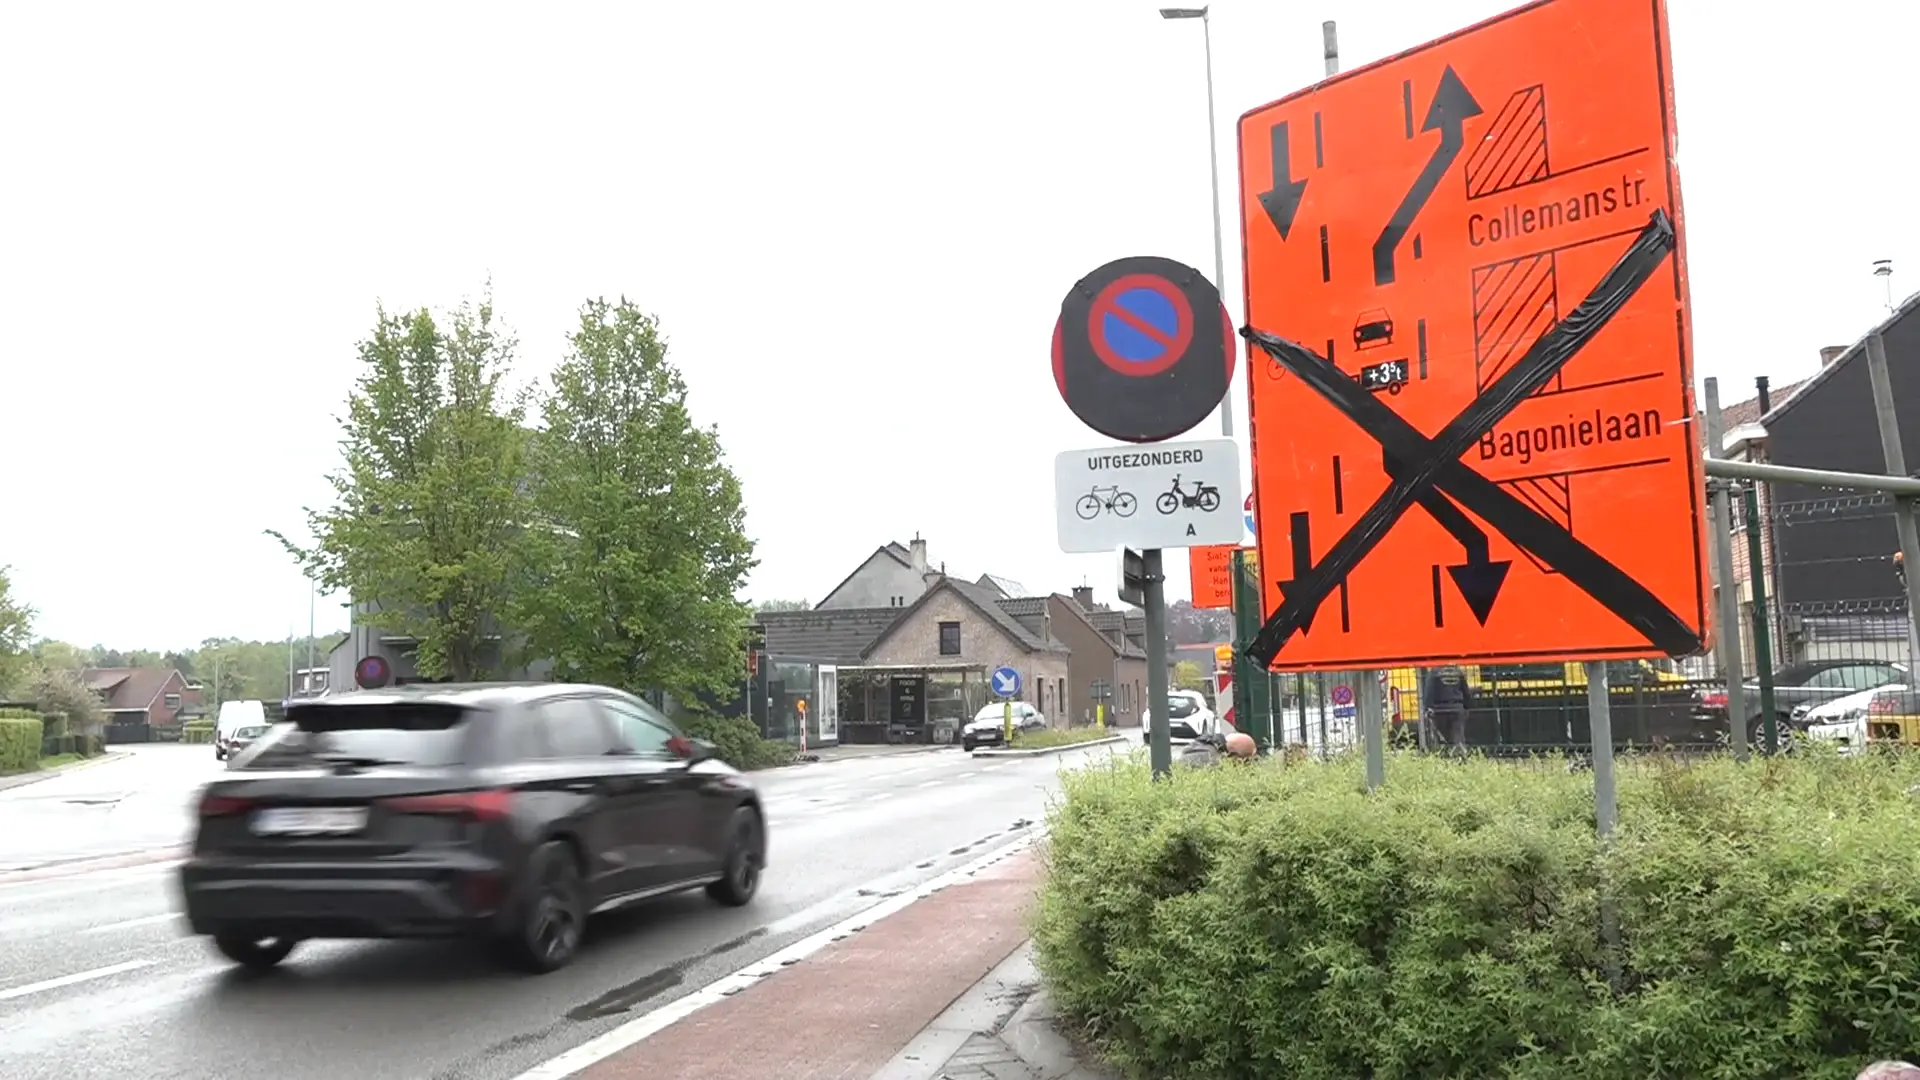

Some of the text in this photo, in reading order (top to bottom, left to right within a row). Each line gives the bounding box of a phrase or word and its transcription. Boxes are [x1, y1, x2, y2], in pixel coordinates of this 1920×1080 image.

[1468, 174, 1651, 247] Collemanstr.
[1479, 408, 1662, 464] Bagonielaan
[1087, 449, 1204, 471] UITGEZONDERD
[1186, 523, 1197, 536] A
